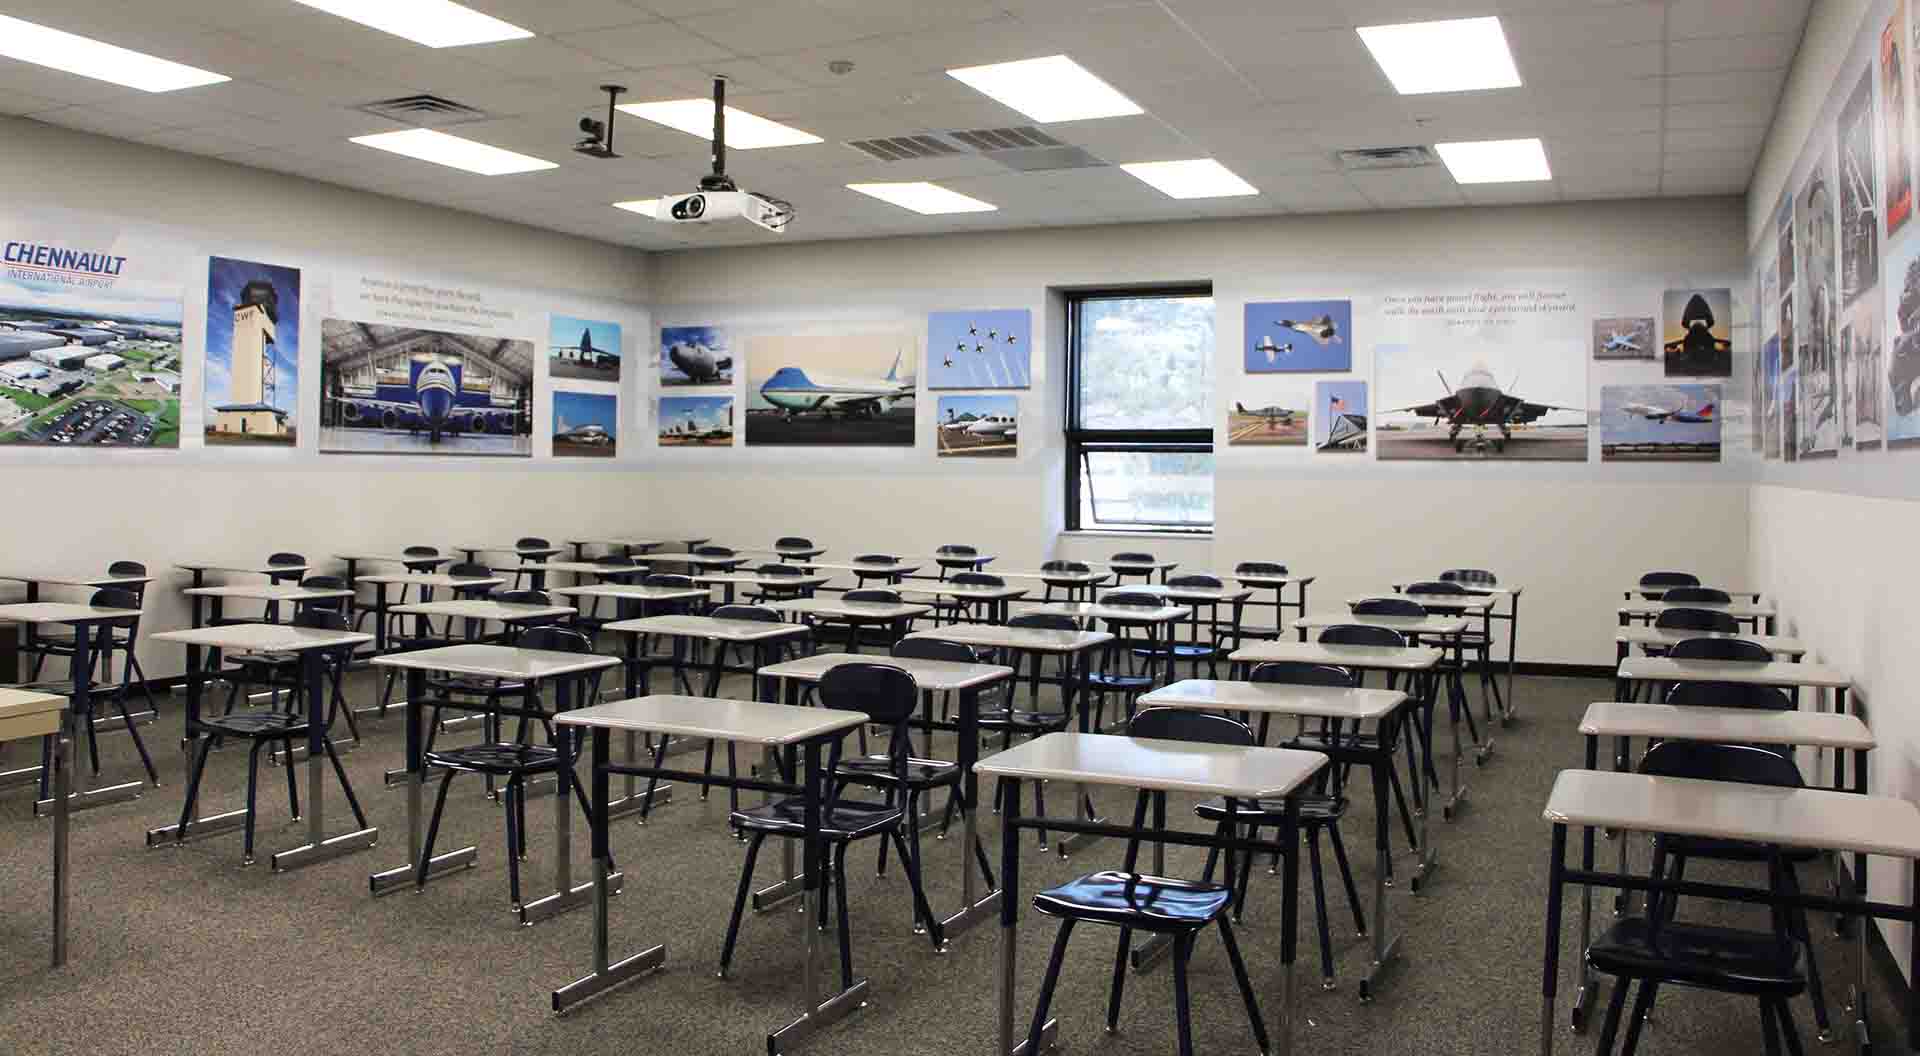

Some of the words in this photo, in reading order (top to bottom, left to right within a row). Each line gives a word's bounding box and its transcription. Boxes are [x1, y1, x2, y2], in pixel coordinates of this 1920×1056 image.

[4, 242, 127, 275] CHENNAULT
[8, 269, 76, 286] INTERNATIONAL
[79, 277, 113, 289] AIRPORT
